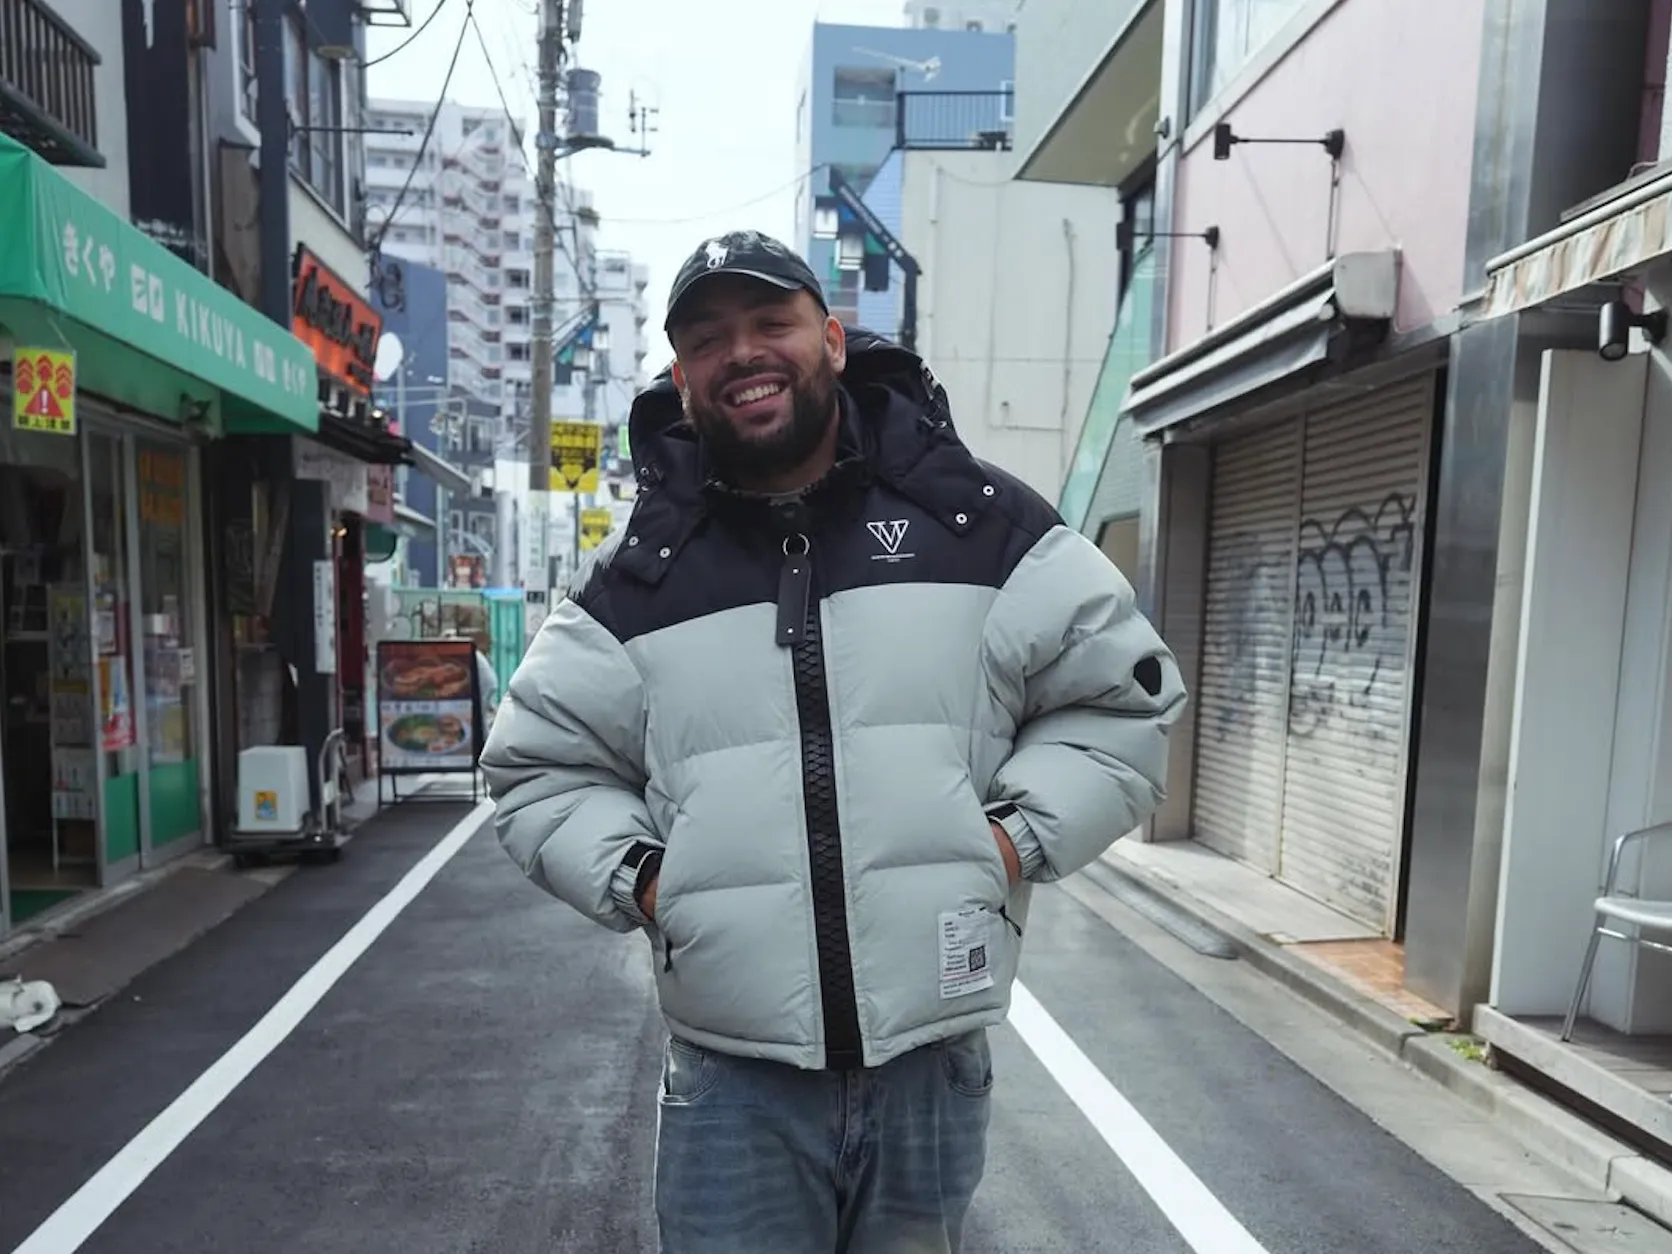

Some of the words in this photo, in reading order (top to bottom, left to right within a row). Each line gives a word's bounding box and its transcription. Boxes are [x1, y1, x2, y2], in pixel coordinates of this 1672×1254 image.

[62, 220, 115, 294] きくや
[175, 288, 246, 369] KIKUYA
